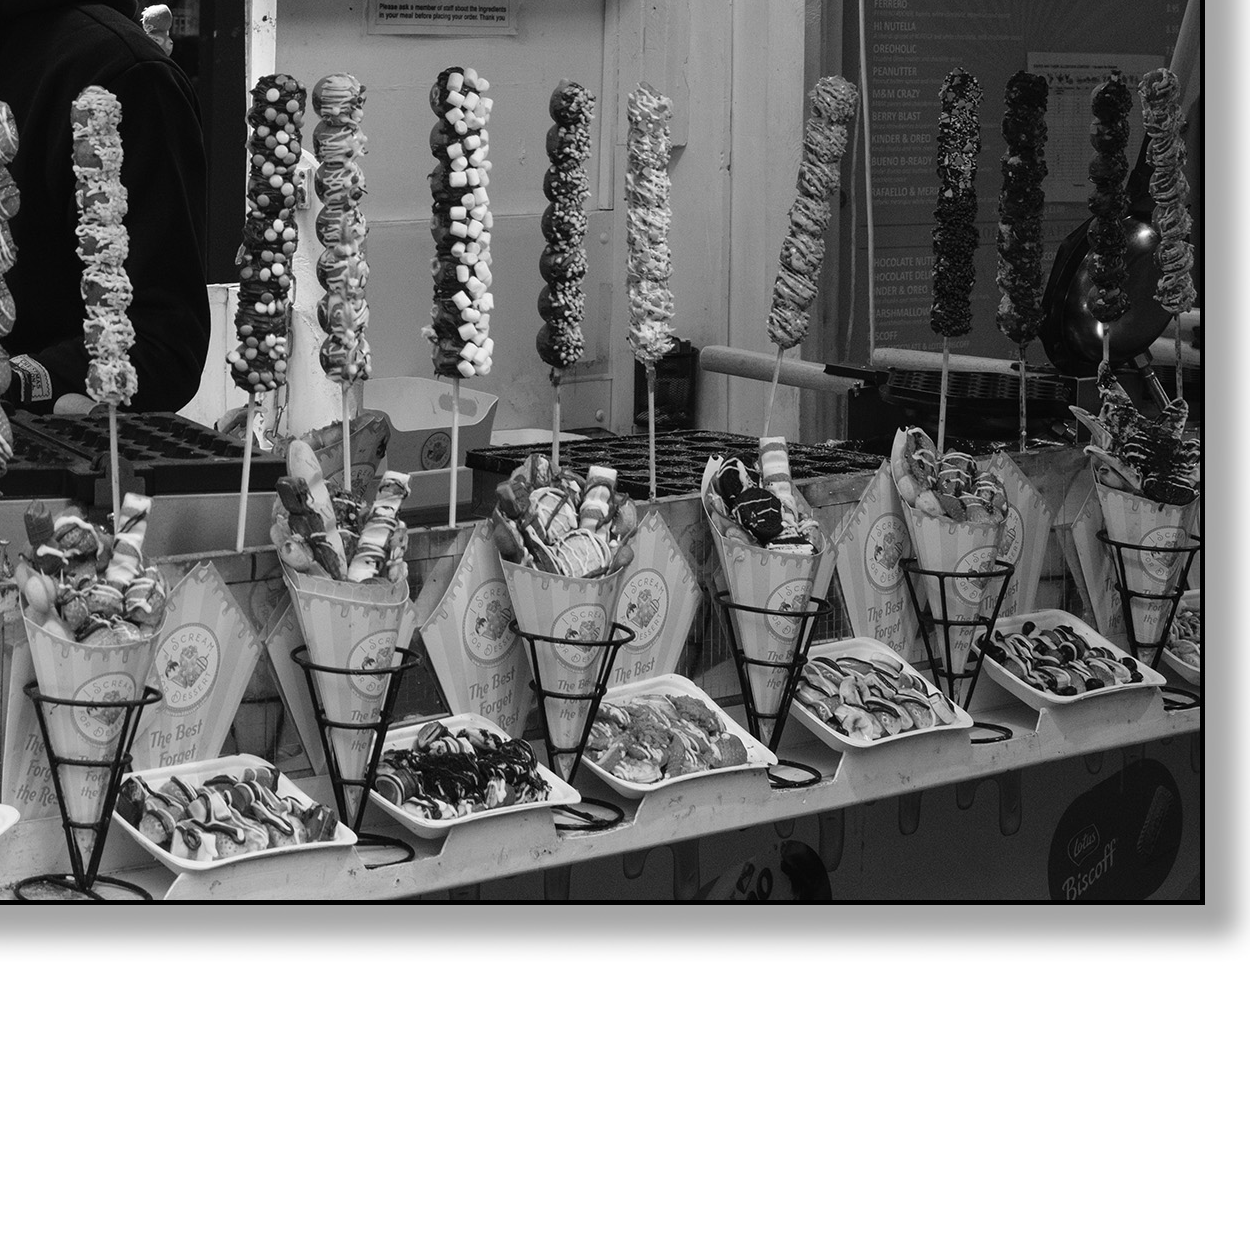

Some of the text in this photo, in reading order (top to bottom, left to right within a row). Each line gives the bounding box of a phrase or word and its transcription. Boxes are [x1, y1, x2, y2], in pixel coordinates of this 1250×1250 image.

[478, 5, 507, 13] ingredients
[874, 0, 908, 9] FERRERO
[432, 13, 451, 21] placing
[479, 13, 495, 21] Thank
[884, 21, 917, 31] NUTELLA
[873, 44, 917, 54] OREOHOLIC
[872, 66, 918, 76] PEANUTTER
[872, 89, 921, 99] M&M CRAZY
[871, 111, 922, 121] BERRY BLAST
[871, 134, 901, 144] KINDER
[909, 134, 931, 144] OREO
[871, 156, 899, 166] BUENO
[871, 186, 908, 197] RAFAELLO
[873, 256, 936, 268] HOCOLATE NUTE
[873, 271, 914, 282] HOCOLATE
[906, 285, 928, 295] OREO
[875, 307, 931, 318] ARSHMALLOW
[875, 521, 907, 538] SCREAM
[629, 577, 665, 595] SCREAM
[475, 587, 507, 609] SCREA
[867, 597, 905, 624] The Best
[873, 618, 902, 640] Forget
[170, 632, 215, 652] SCREAM
[469, 631, 482, 651] FOR
[953, 639, 969, 652] the
[767, 650, 785, 663] The
[615, 656, 656, 684] The Best
[92, 678, 133, 695] SCREAM
[170, 672, 211, 704] DESSERT
[469, 665, 516, 701] The Best
[558, 679, 576, 693] The
[766, 677, 783, 690] the
[479, 688, 513, 717] Forget
[77, 709, 92, 729] FOR
[351, 709, 369, 722] The
[497, 706, 520, 732] Rest
[559, 708, 577, 722] the
[150, 718, 203, 750] The Best
[25, 733, 46, 756] The
[351, 739, 368, 752] the
[159, 743, 197, 769] Forget
[26, 759, 52, 783] Forg
[16, 784, 37, 805] the
[80, 786, 99, 800] the
[1073, 830, 1097, 858] Lotus
[1062, 837, 1118, 900] Biscoff
